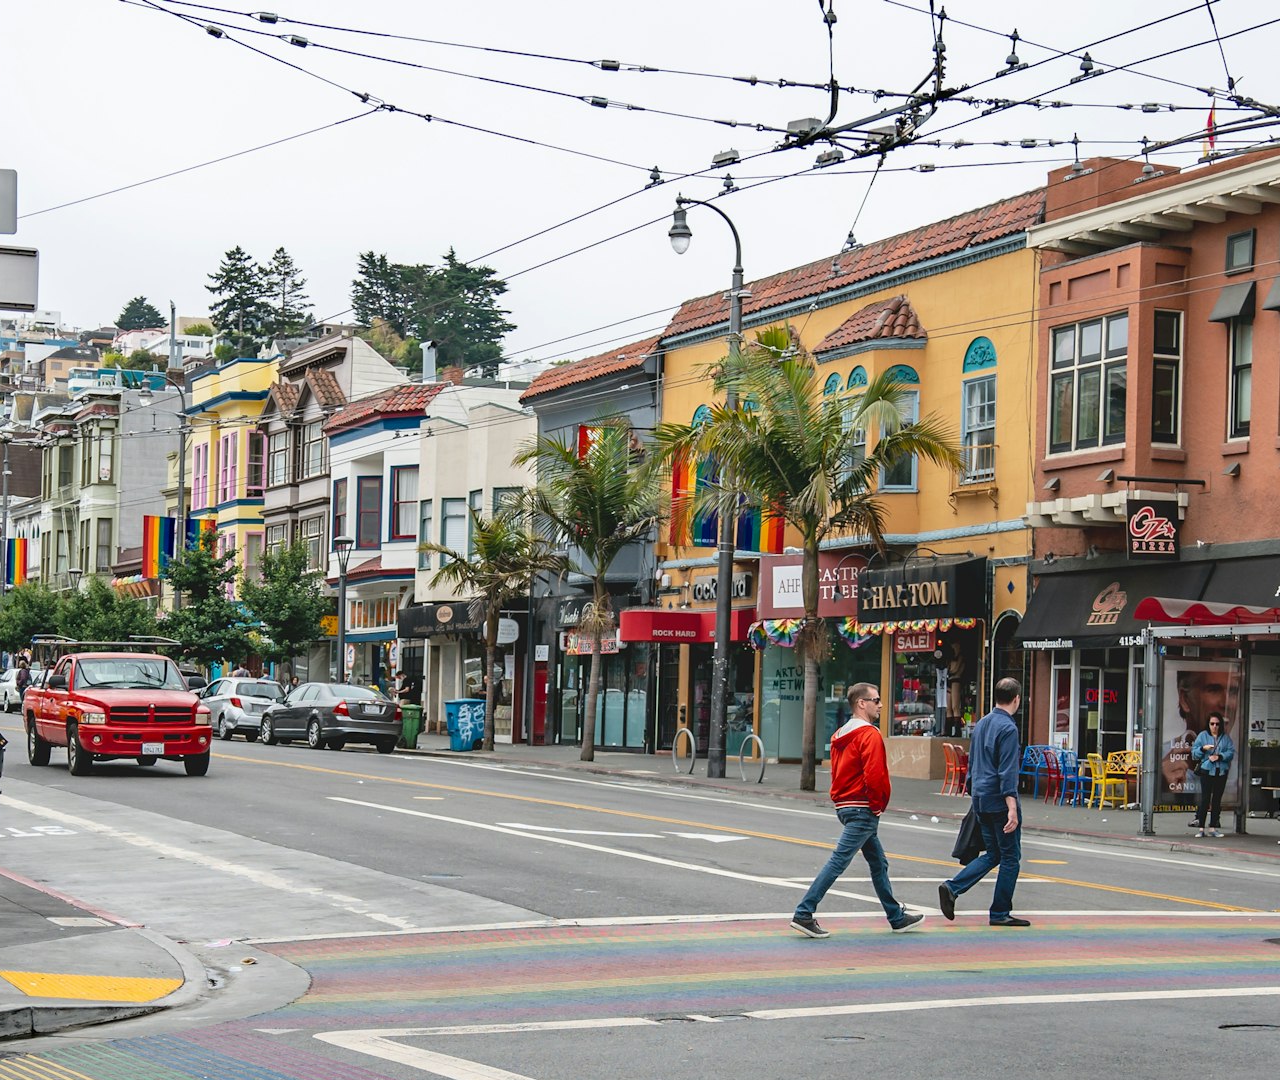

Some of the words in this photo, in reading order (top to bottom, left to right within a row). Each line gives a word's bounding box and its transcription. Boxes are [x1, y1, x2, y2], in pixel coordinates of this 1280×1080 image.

[1132, 541, 1175, 551] PIZZA
[818, 566, 867, 582] ASTR
[778, 578, 801, 594] AHF
[1087, 613, 1119, 624] PIZZA
[652, 629, 674, 637] ROCK
[897, 635, 930, 650] SALE!
[1086, 688, 1119, 703] OPEN
[1170, 740, 1190, 749] Let's
[1169, 753, 1190, 763] your
[1168, 782, 1200, 791] CANDI
